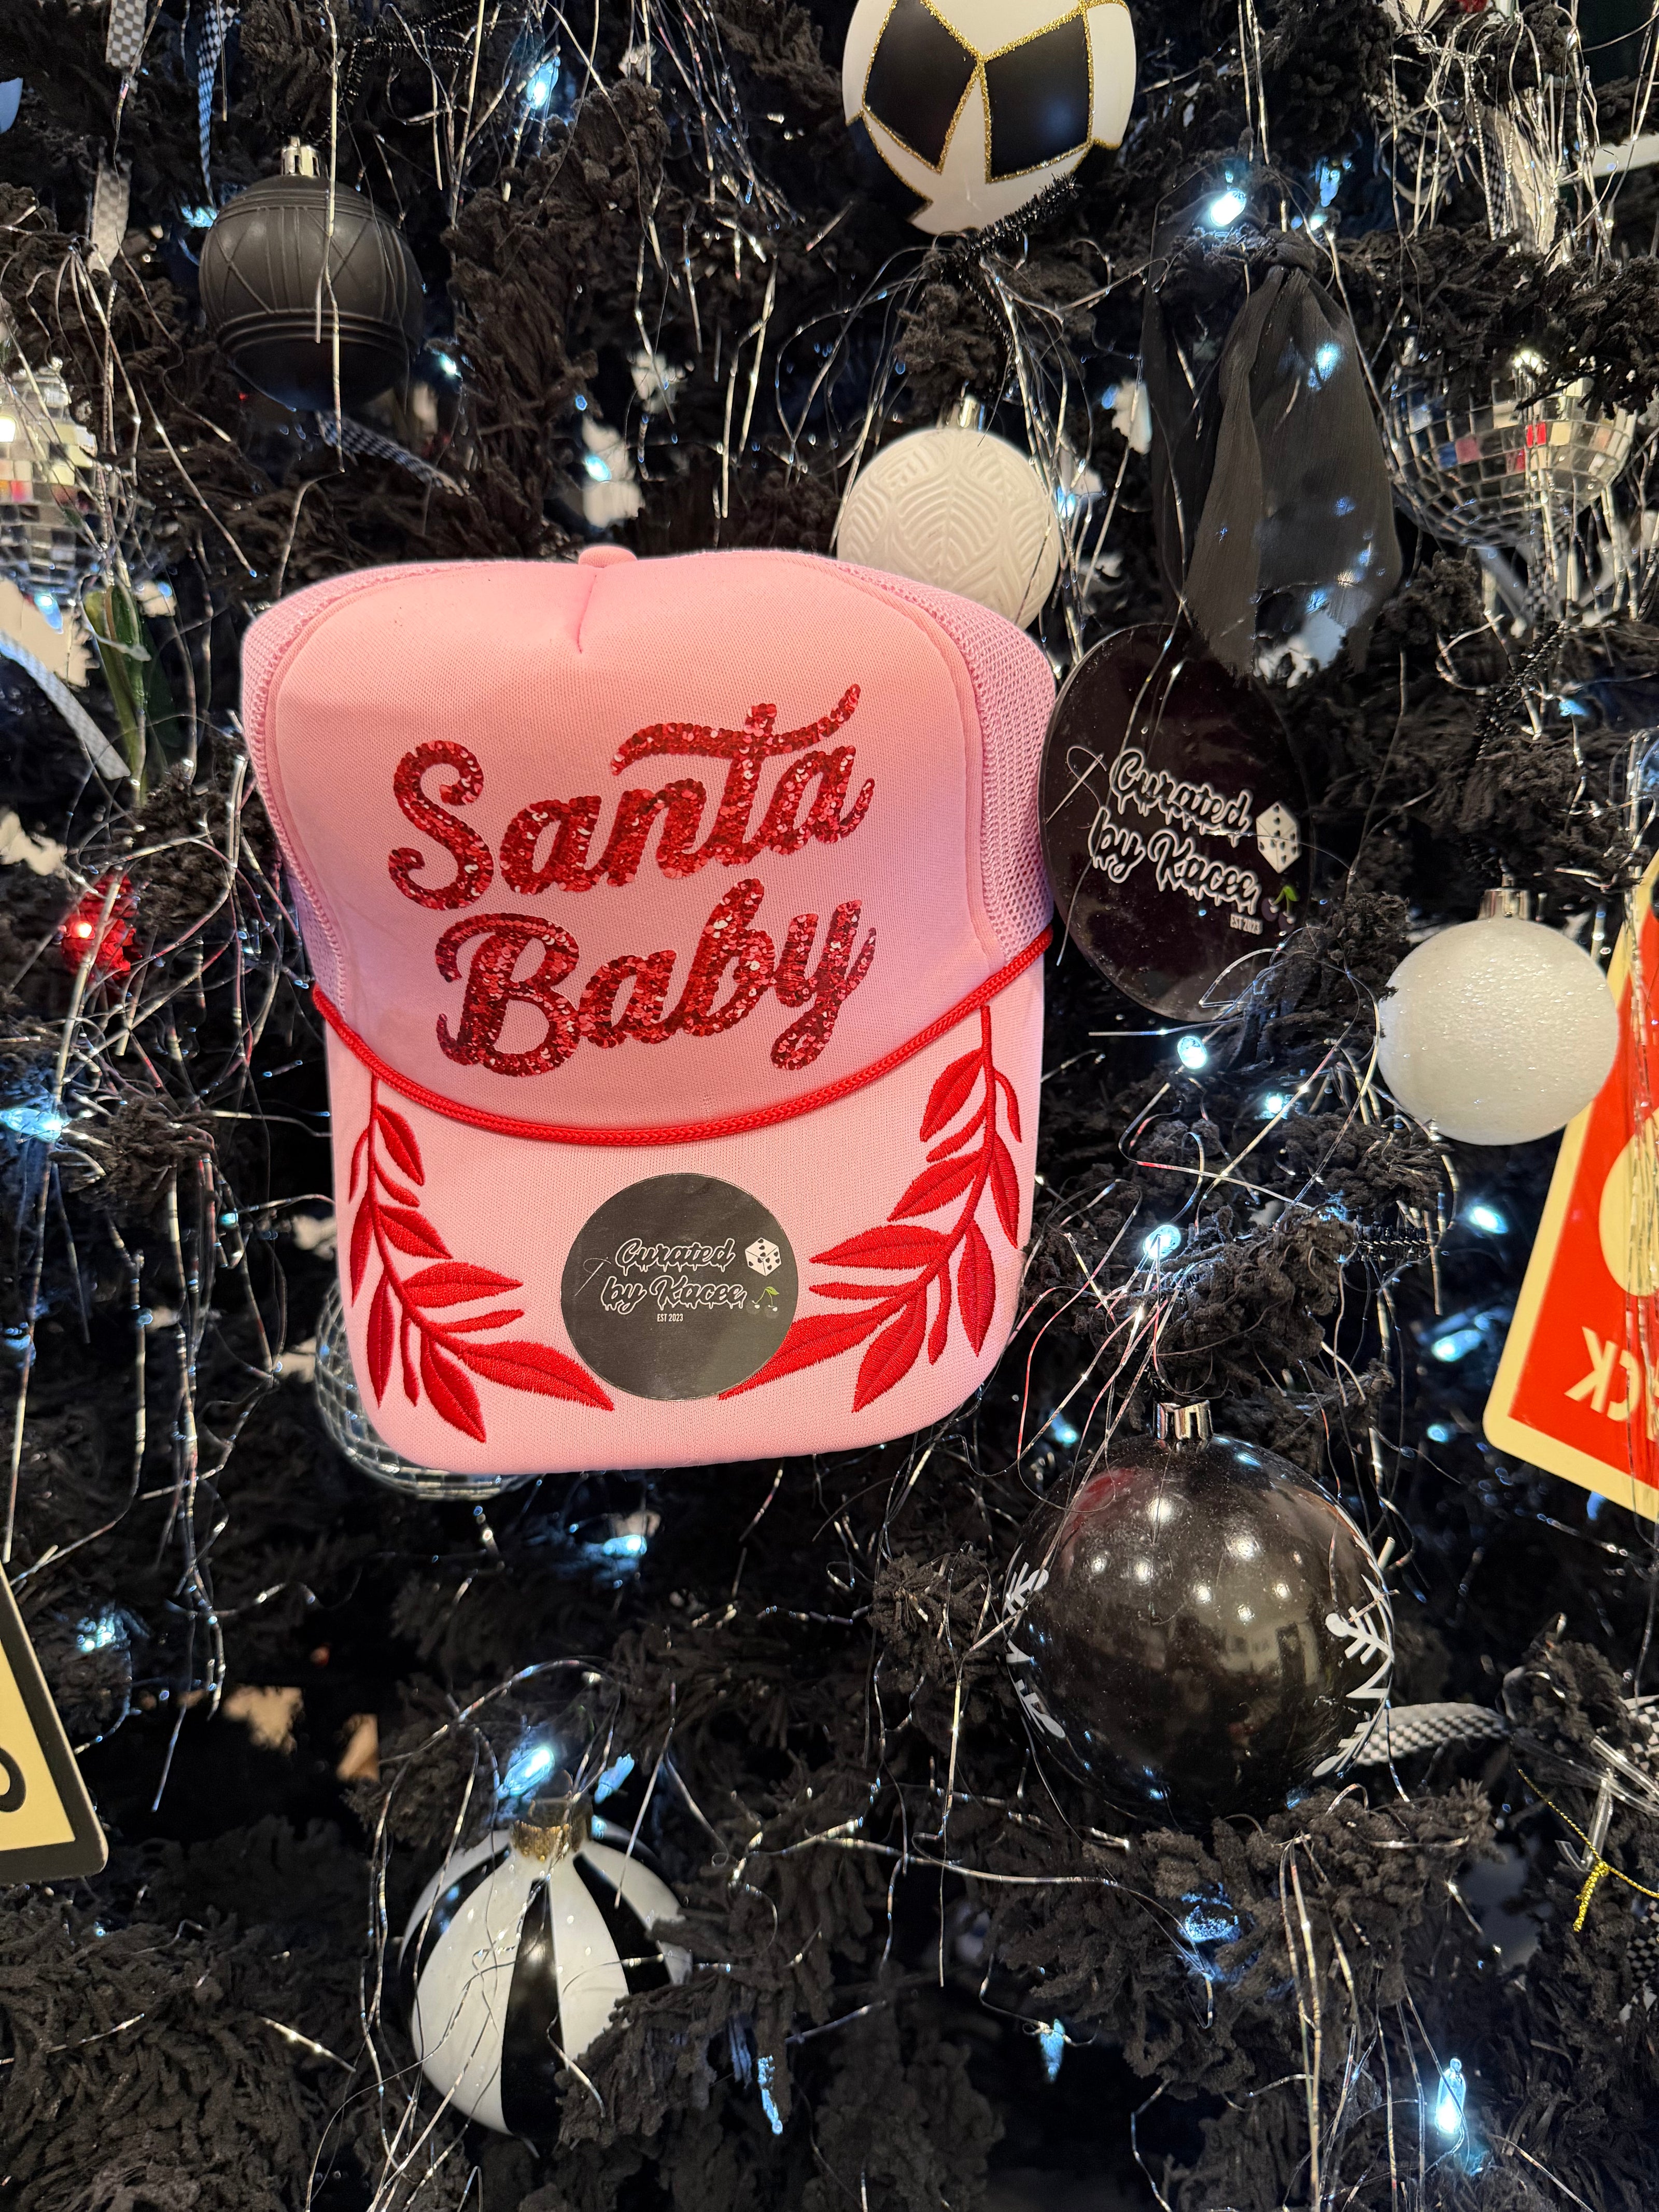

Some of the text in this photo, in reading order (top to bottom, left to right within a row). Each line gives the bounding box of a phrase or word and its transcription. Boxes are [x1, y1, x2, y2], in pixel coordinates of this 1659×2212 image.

[388, 684, 875, 910] Santa
[1109, 748, 1253, 848] Curated
[1089, 806, 1146, 883] by
[1230, 913, 1262, 935] EST 2023
[435, 878, 877, 1077] Baby
[615, 1237, 736, 1276] Curated
[601, 1275, 747, 1315] by Kacee
[657, 1313, 684, 1322] EST 2023
